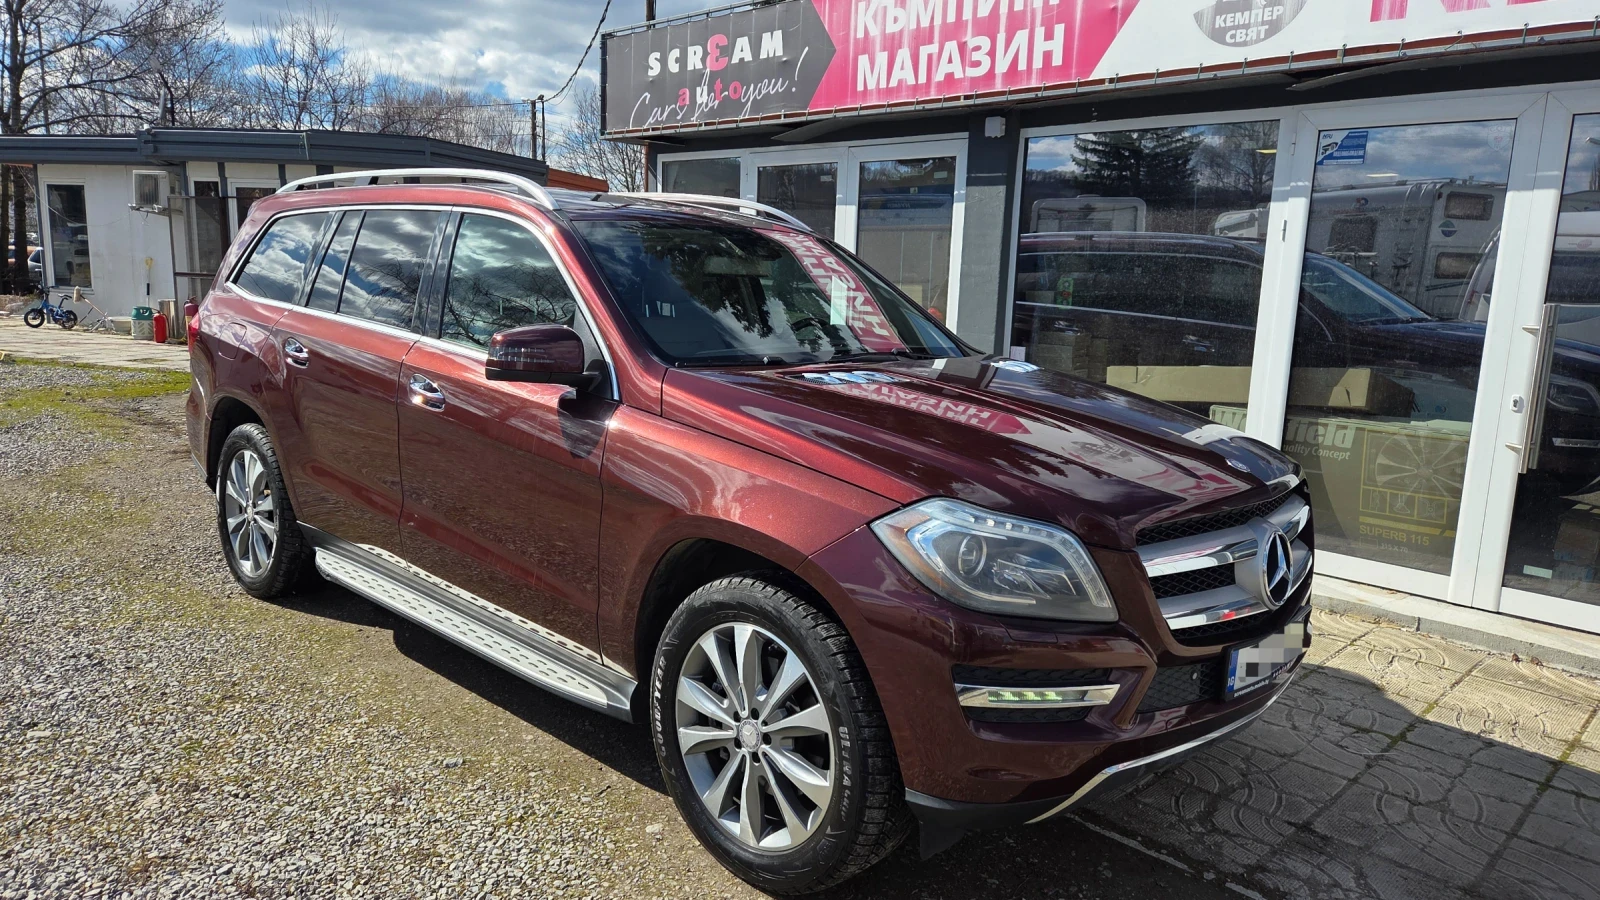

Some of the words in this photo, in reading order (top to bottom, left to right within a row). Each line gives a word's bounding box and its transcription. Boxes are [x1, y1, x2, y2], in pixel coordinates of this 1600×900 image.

[856, 0, 1059, 39] КЪМП
[1215, 5, 1284, 28] КЕМПЕР
[1225, 25, 1269, 43] СВЯТ
[648, 30, 784, 77] SCREAM
[857, 24, 1065, 92] МАГАЗИН
[678, 78, 742, 106] auto
[630, 92, 688, 129] Cars
[1283, 443, 1311, 457] uality
[1312, 446, 1351, 461] Concept
[1359, 525, 1407, 542] SUPERB
[1411, 534, 1430, 546] 115
